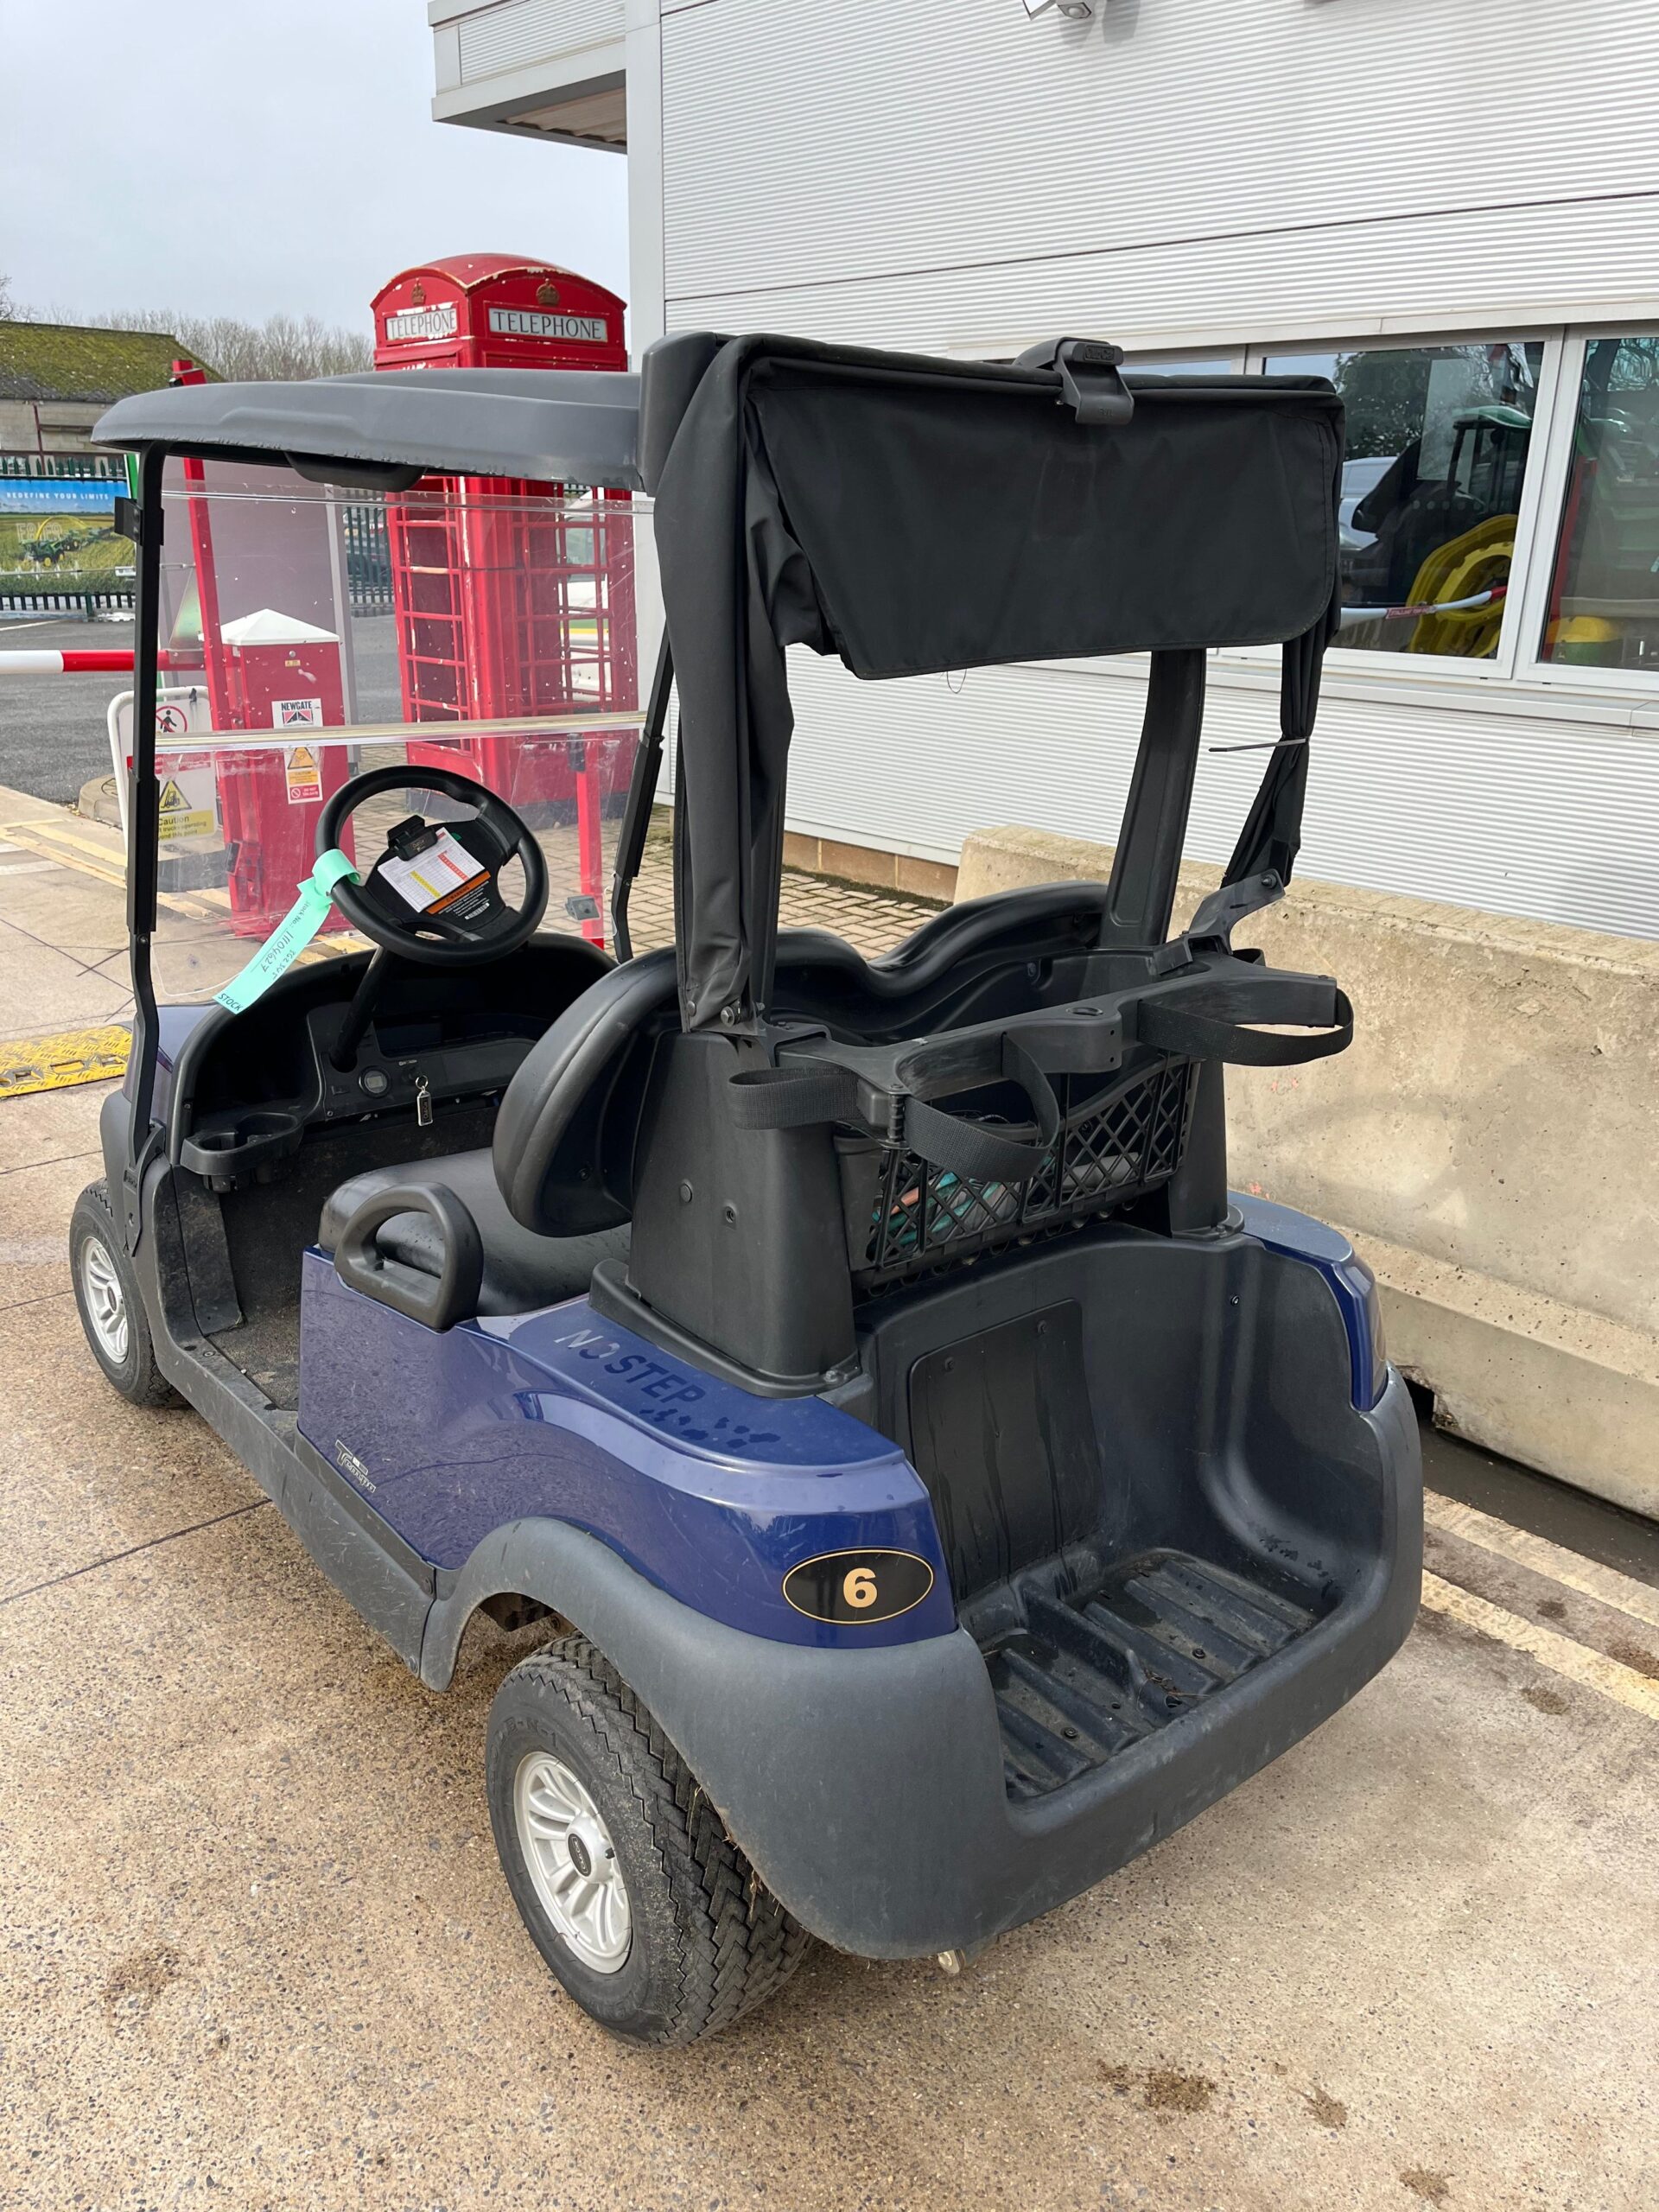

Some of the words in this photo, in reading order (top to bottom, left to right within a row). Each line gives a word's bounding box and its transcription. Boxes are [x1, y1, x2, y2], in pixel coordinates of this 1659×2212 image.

[389, 308, 457, 339] TELEPHONE
[493, 311, 602, 340] TELEPHONE
[281, 701, 312, 711] NEWGATE
[158, 816, 190, 825] Caution
[218, 993, 243, 1011] STOCK
[604, 1355, 707, 1403] STEP
[334, 1439, 377, 1494] Tempo
[842, 1567, 878, 1608] 6
